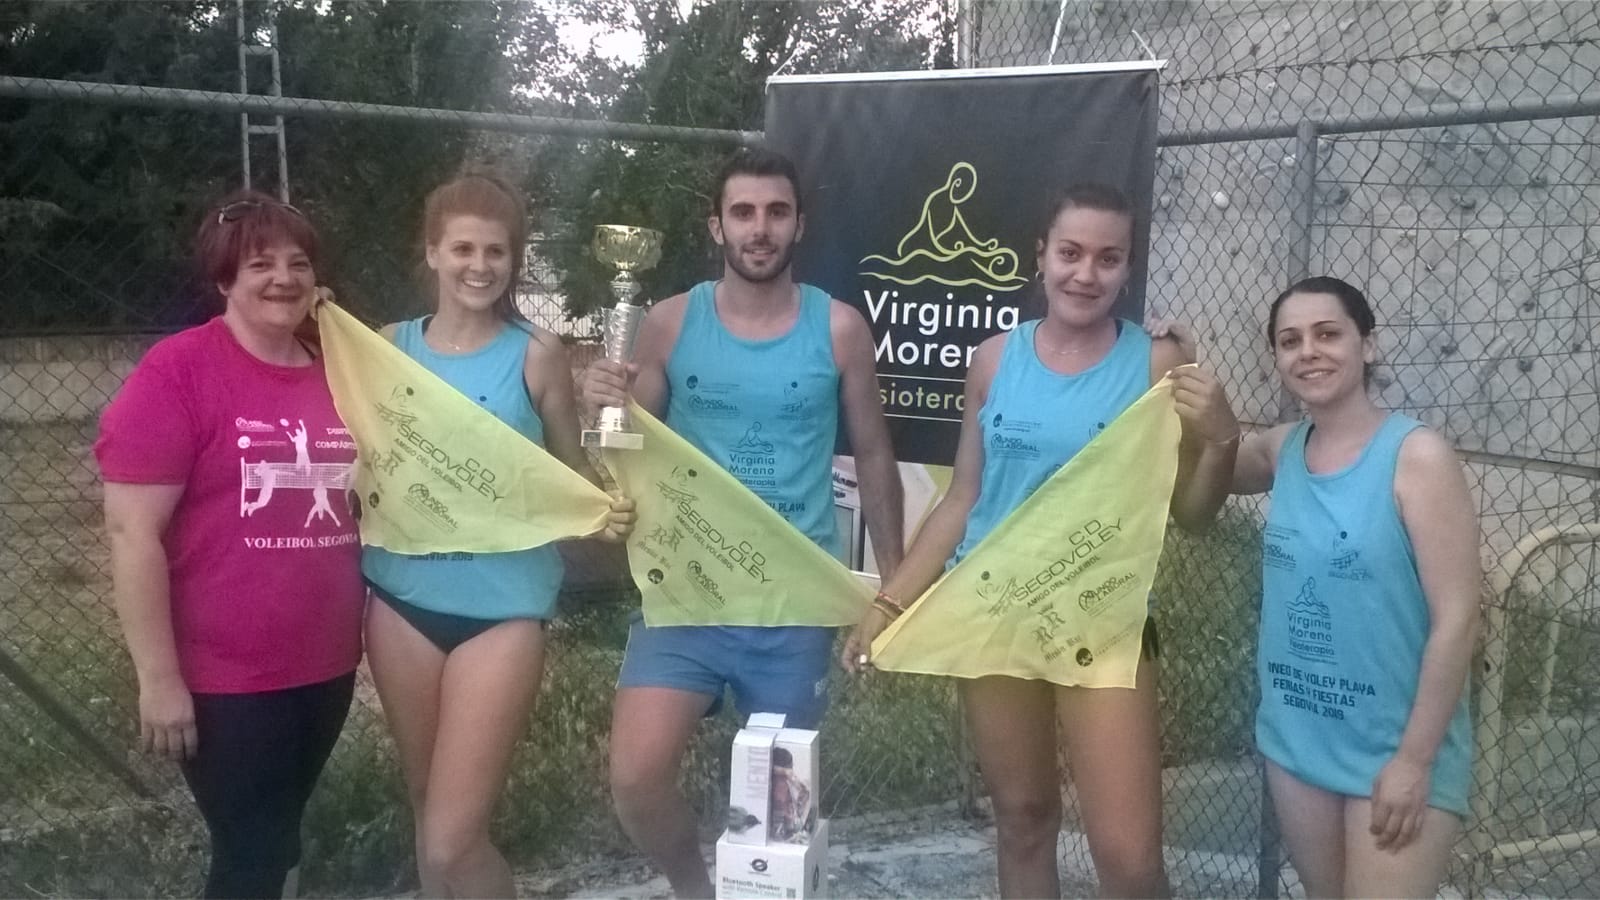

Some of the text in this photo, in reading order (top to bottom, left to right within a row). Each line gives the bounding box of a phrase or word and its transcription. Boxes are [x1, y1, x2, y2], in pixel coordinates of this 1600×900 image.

[864, 290, 1019, 335] Virginia
[398, 423, 504, 503] SEGOVOLEY
[728, 466, 775, 476] Moreno
[729, 454, 775, 466] Virginia
[244, 532, 358, 549] VOLEIBOL SEGOVIA
[678, 501, 774, 585] SEGOVOLEY
[1014, 517, 1122, 602] SEGOVOLEY
[1027, 555, 1102, 609] AMIGO DEL VOLEIBOL
[1286, 611, 1332, 630] Virginia
[1288, 624, 1333, 642] Moreno
[1272, 677, 1305, 695] FERIAS
[1312, 688, 1355, 707] FIESTAS
[1304, 671, 1336, 689] VOLEY
[1339, 678, 1376, 697] PLAYA
[1283, 693, 1345, 721] SEGOVIA 2019
